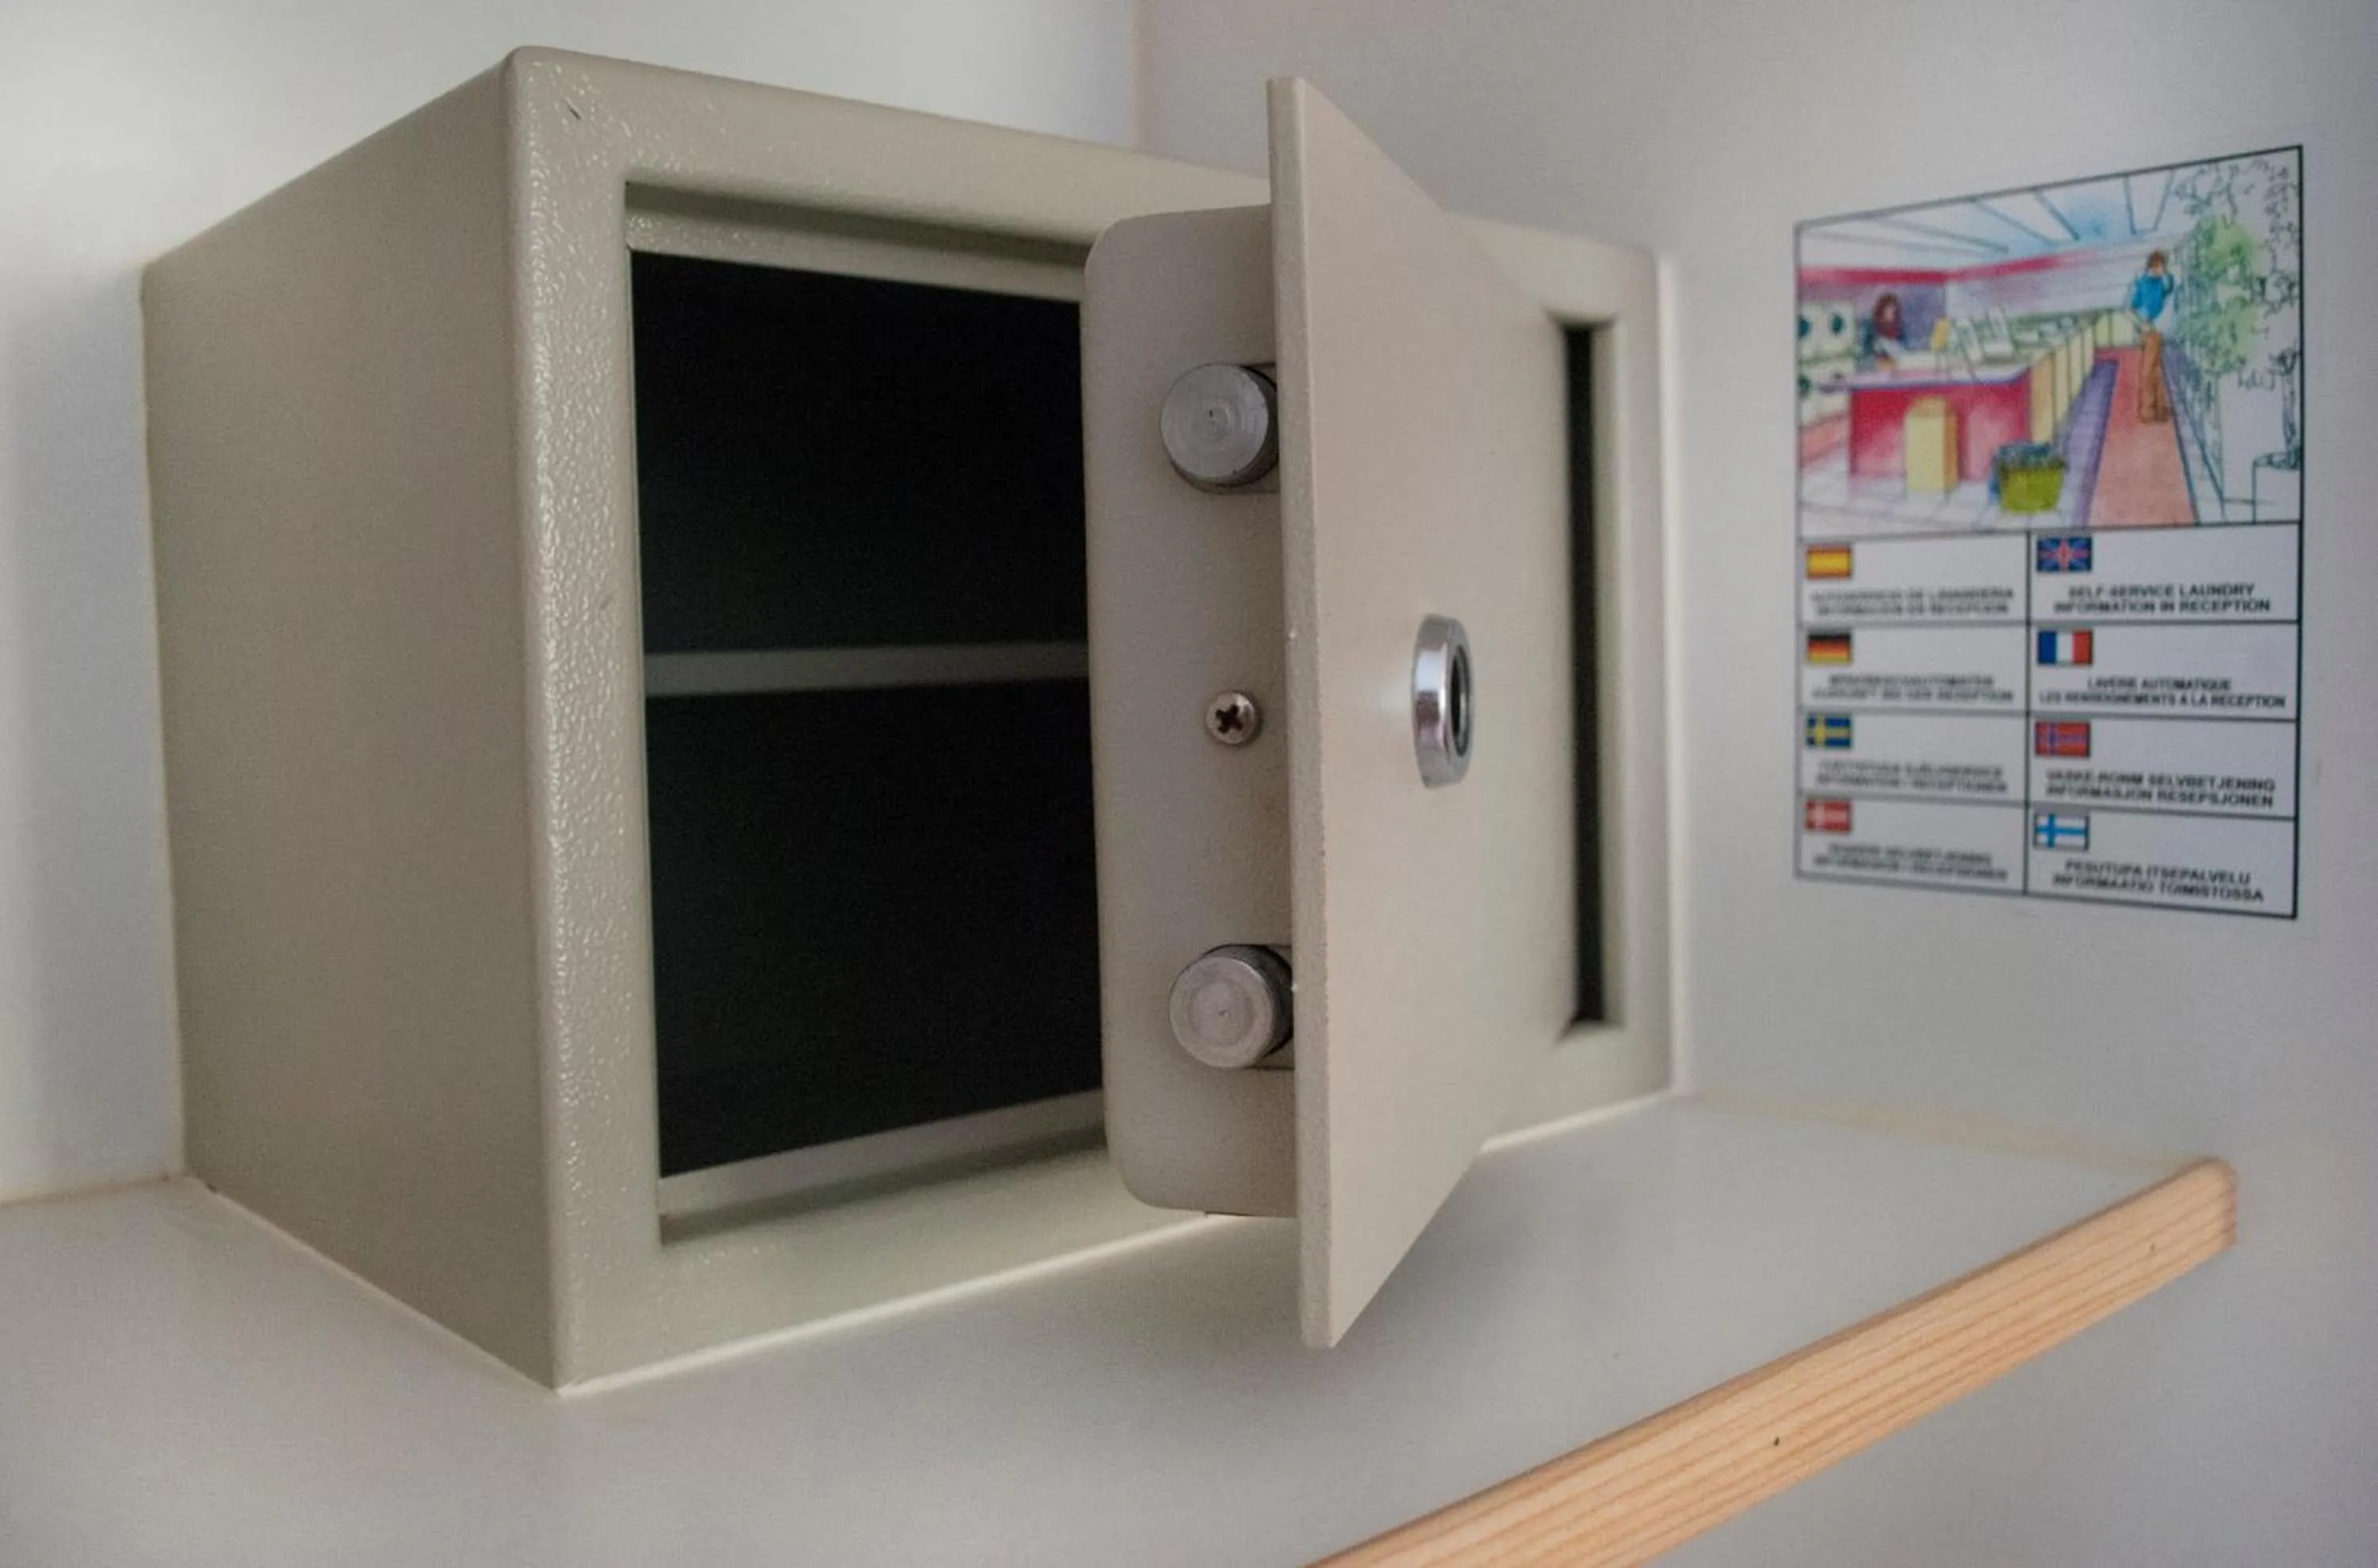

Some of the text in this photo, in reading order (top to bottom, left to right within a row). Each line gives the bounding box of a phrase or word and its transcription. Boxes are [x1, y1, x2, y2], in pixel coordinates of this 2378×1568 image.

[2179, 583, 2255, 596] LAUNDRY
[2180, 599, 2270, 613] RECEPTION
[2191, 694, 2207, 706] LA
[2211, 694, 2286, 708] RECEPTION
[2157, 790, 2273, 809] RESEPSJONEN
[2147, 864, 2251, 885] ITSEPALVELU
